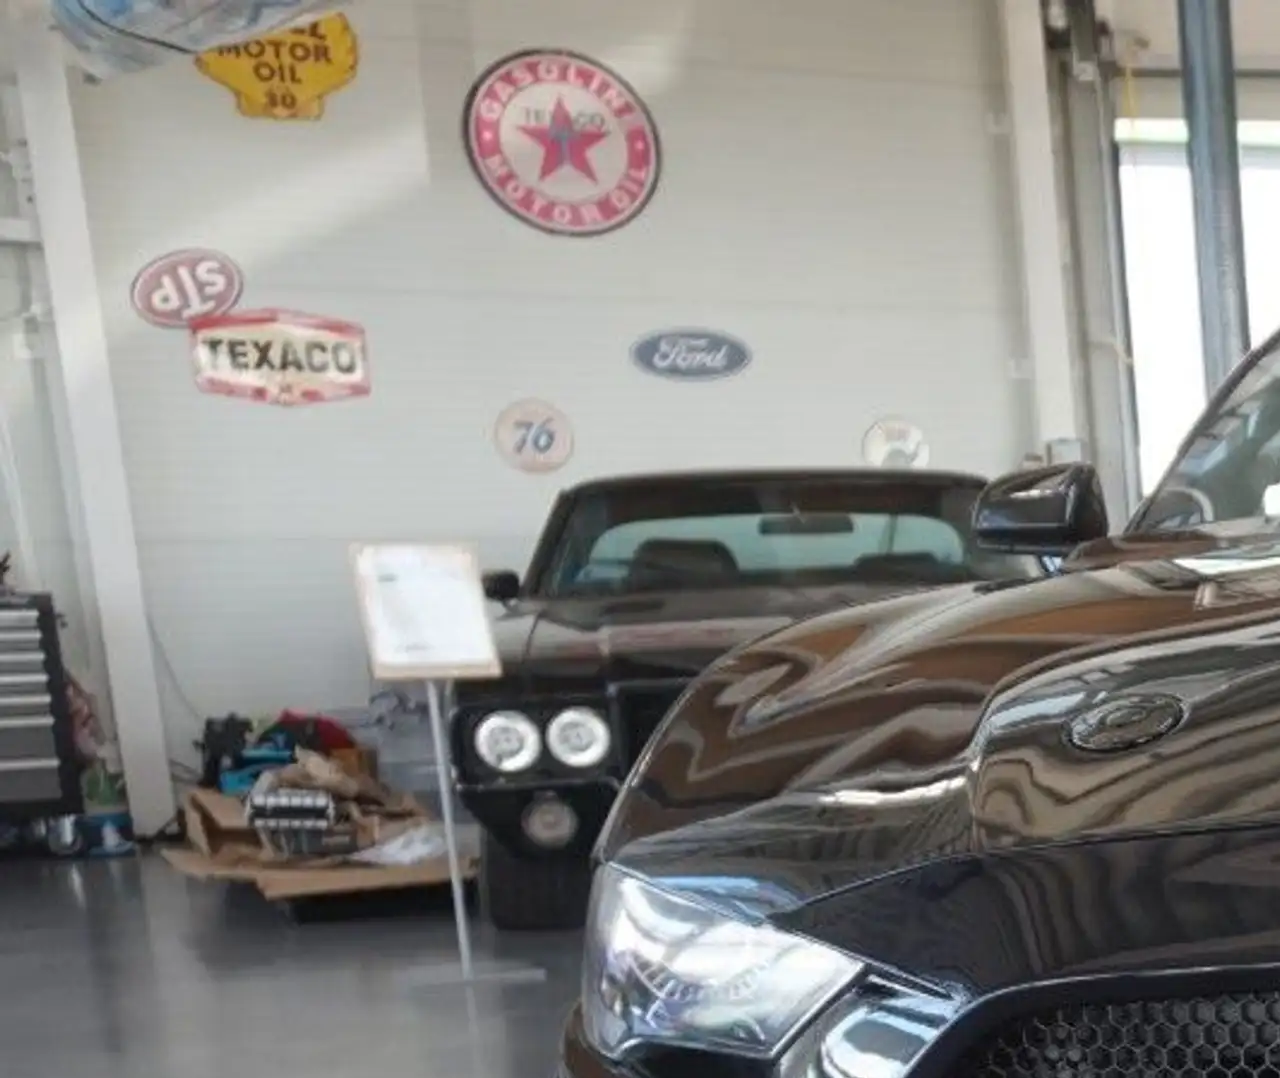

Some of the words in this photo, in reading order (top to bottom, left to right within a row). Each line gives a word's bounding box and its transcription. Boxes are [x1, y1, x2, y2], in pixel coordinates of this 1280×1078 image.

[253, 62, 302, 84] OIL
[151, 260, 228, 320] STP
[201, 337, 357, 374] TEXACO
[651, 336, 729, 371] Ford
[513, 416, 556, 454] 76
